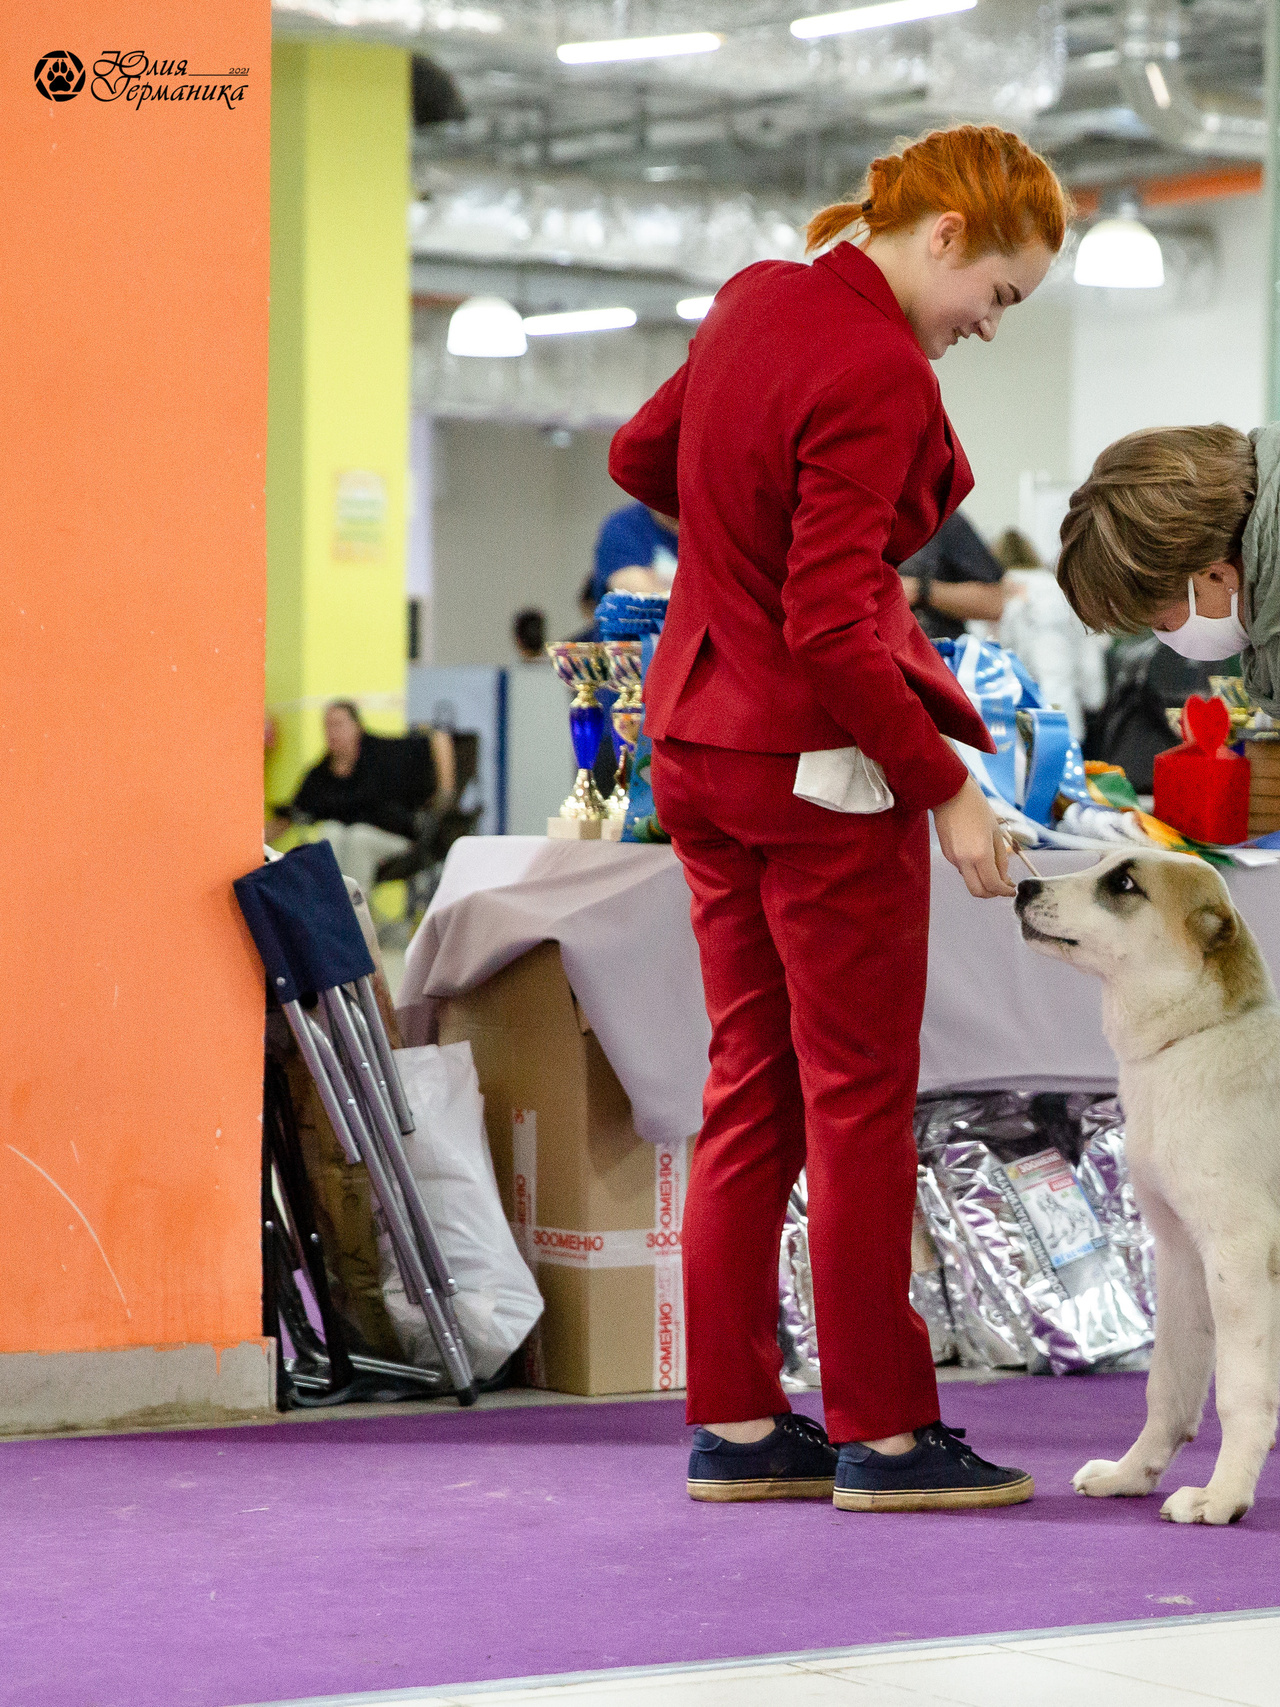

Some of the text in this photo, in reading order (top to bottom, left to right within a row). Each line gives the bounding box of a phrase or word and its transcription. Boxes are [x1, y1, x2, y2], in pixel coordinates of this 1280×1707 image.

[659, 1152, 672, 1228] ОМЕНЮ
[533, 1230, 604, 1251] ЗООМЕНЮ
[646, 1231, 682, 1248] ЗОО
[659, 1302, 672, 1390] ООМЕНЮ
